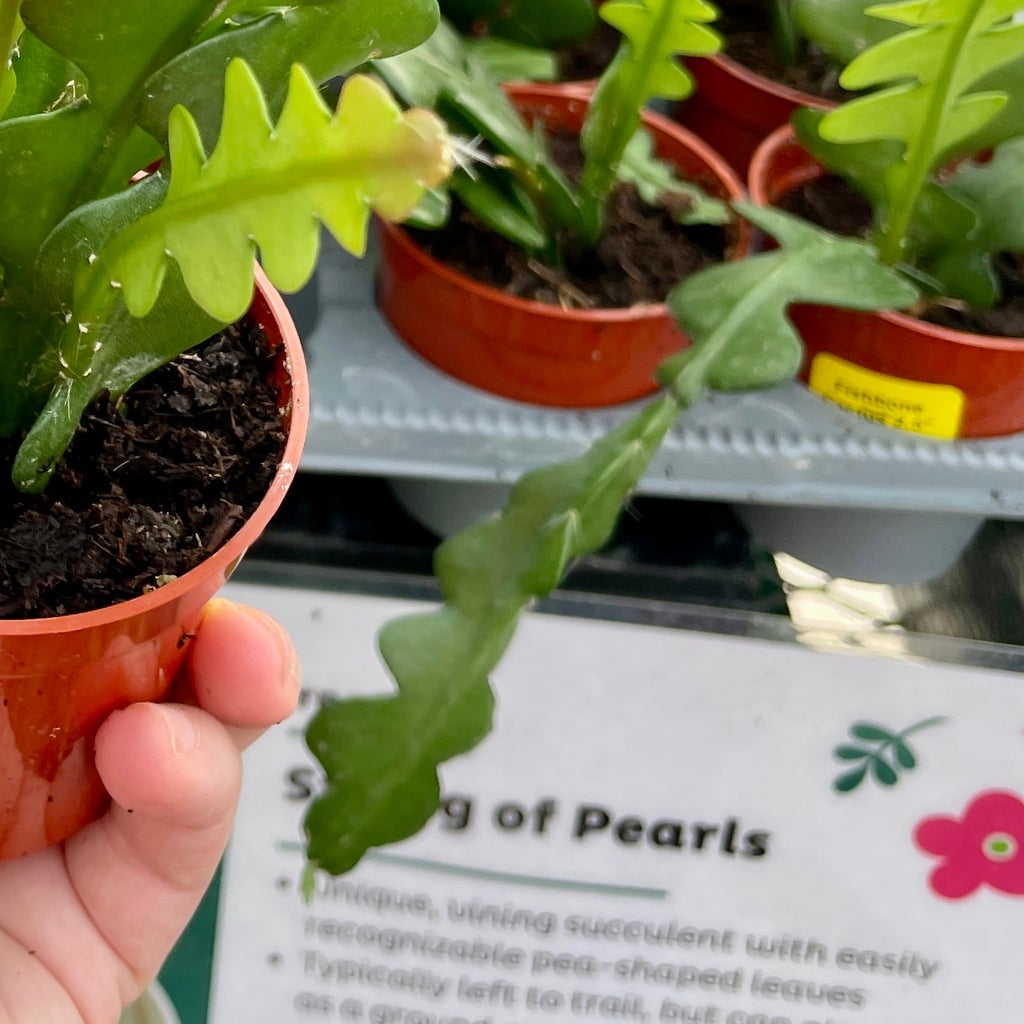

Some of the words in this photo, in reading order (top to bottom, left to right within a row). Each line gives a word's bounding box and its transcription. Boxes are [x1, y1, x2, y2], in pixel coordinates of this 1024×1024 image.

[494, 796, 556, 836] of
[572, 802, 771, 858] Pearls
[303, 914, 525, 970] recognizable
[531, 947, 744, 995] pea-shaped
[750, 970, 867, 1011] leaves
[447, 898, 558, 937] vining
[564, 912, 738, 953] succulent
[744, 933, 829, 966] with
[834, 946, 943, 987] easily
[293, 991, 335, 1016] as
[339, 998, 364, 1020] a
[302, 950, 453, 1002] Typically
[457, 975, 518, 1009] left
[525, 985, 567, 1012] to
[570, 991, 651, 1024] trail,
[659, 996, 720, 1024] but
